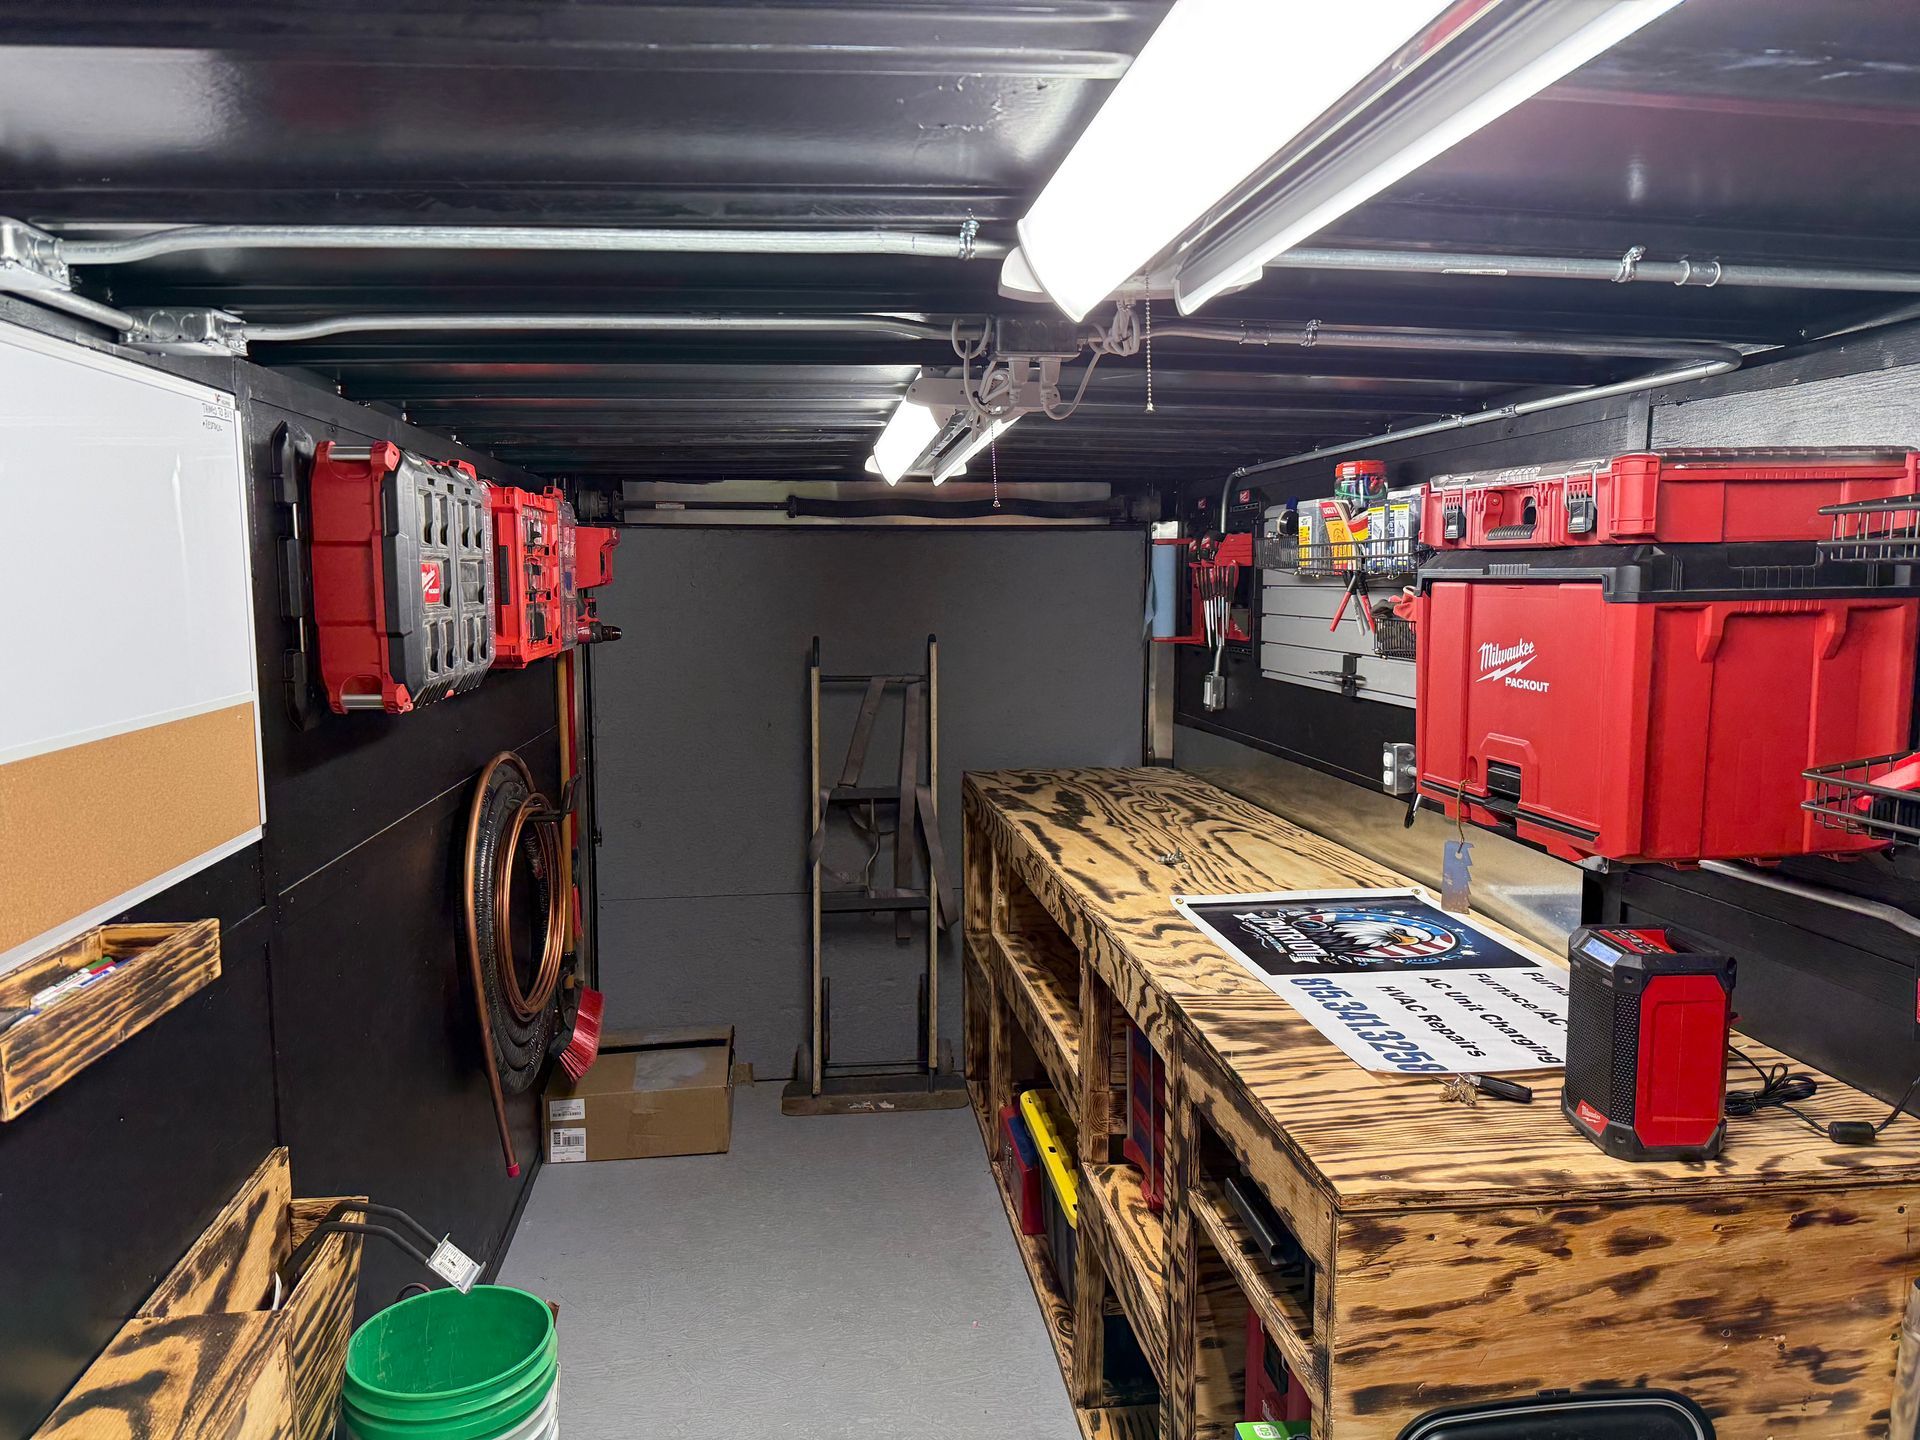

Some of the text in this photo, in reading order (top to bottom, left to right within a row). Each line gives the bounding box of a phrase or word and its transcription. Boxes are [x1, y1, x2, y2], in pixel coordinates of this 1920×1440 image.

[1477, 637, 1535, 672] Milwaukee
[1505, 677, 1550, 692] PACKOUT
[1248, 918, 1330, 957] PATRIOT
[1289, 977, 1450, 1072] 815.341.3258
[1376, 985, 1487, 1058] HVAC Repairs
[1418, 976, 1565, 1065] AC Unit Charging
[1468, 972, 1568, 1027] Furnace/AC
